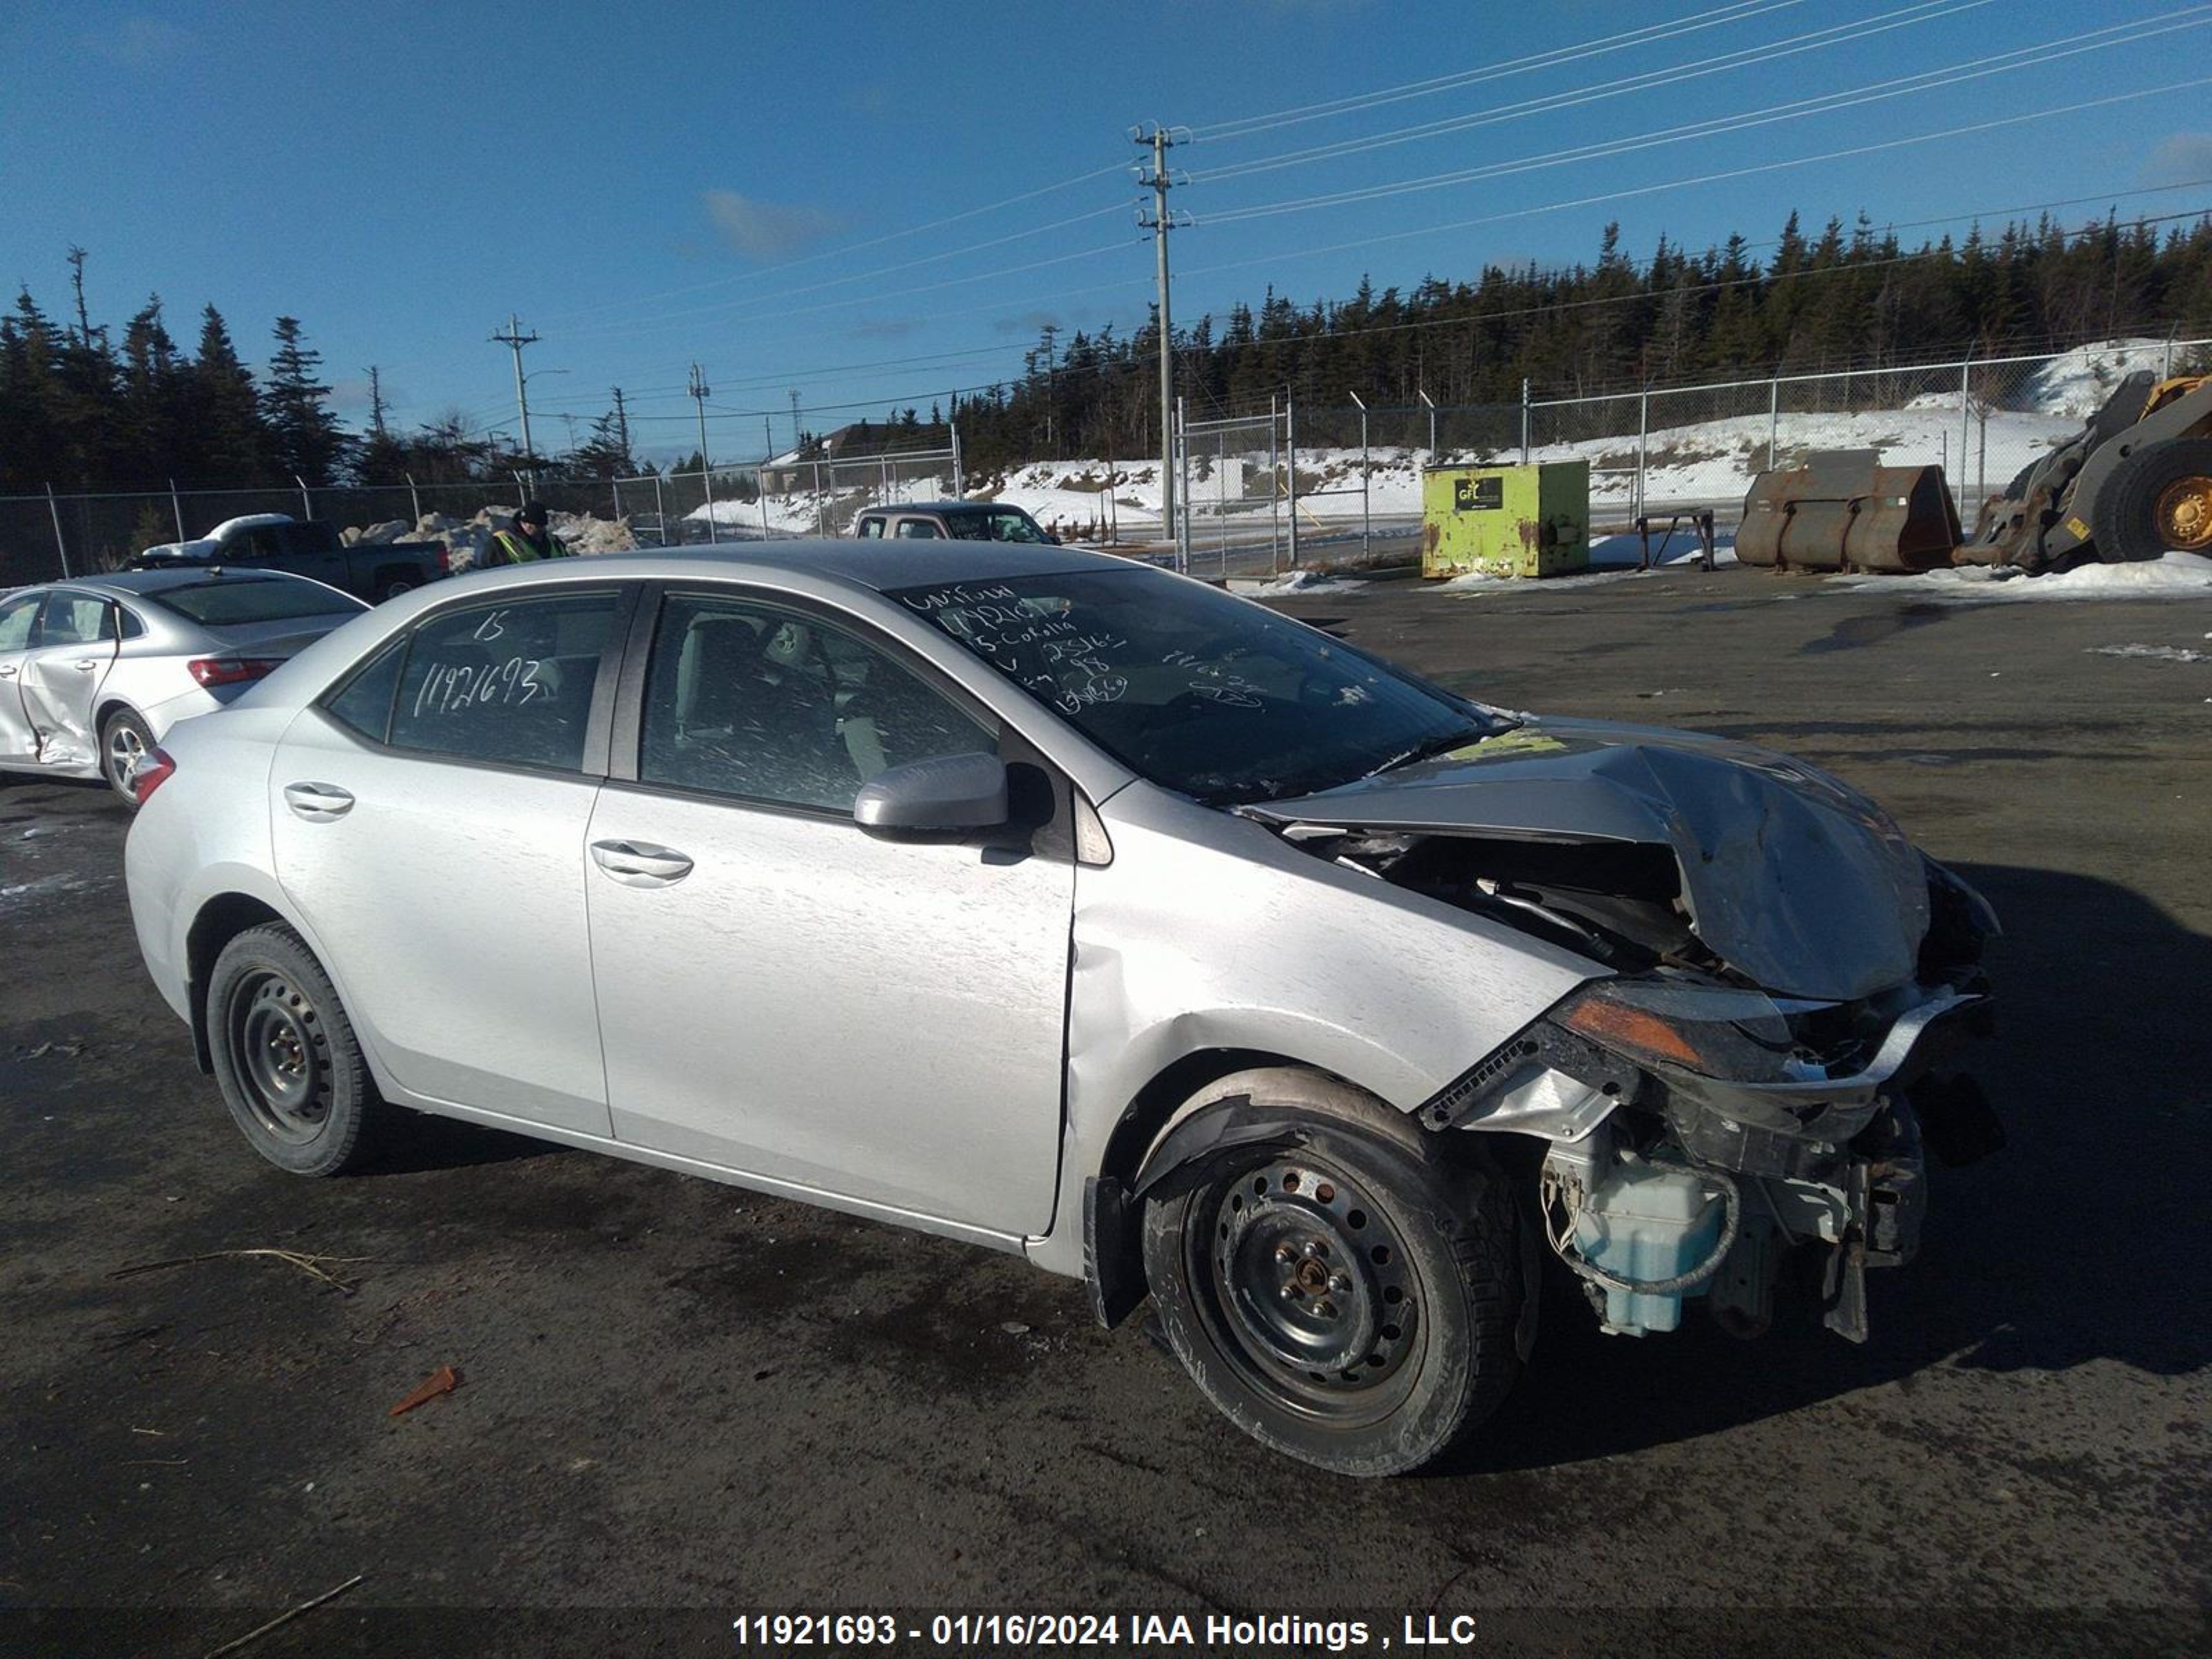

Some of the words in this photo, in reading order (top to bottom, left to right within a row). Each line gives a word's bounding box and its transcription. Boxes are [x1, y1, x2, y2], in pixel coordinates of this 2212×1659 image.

[1459, 489, 1479, 499] GFL
[474, 610, 509, 641] 15
[414, 657, 539, 718] 11921693
